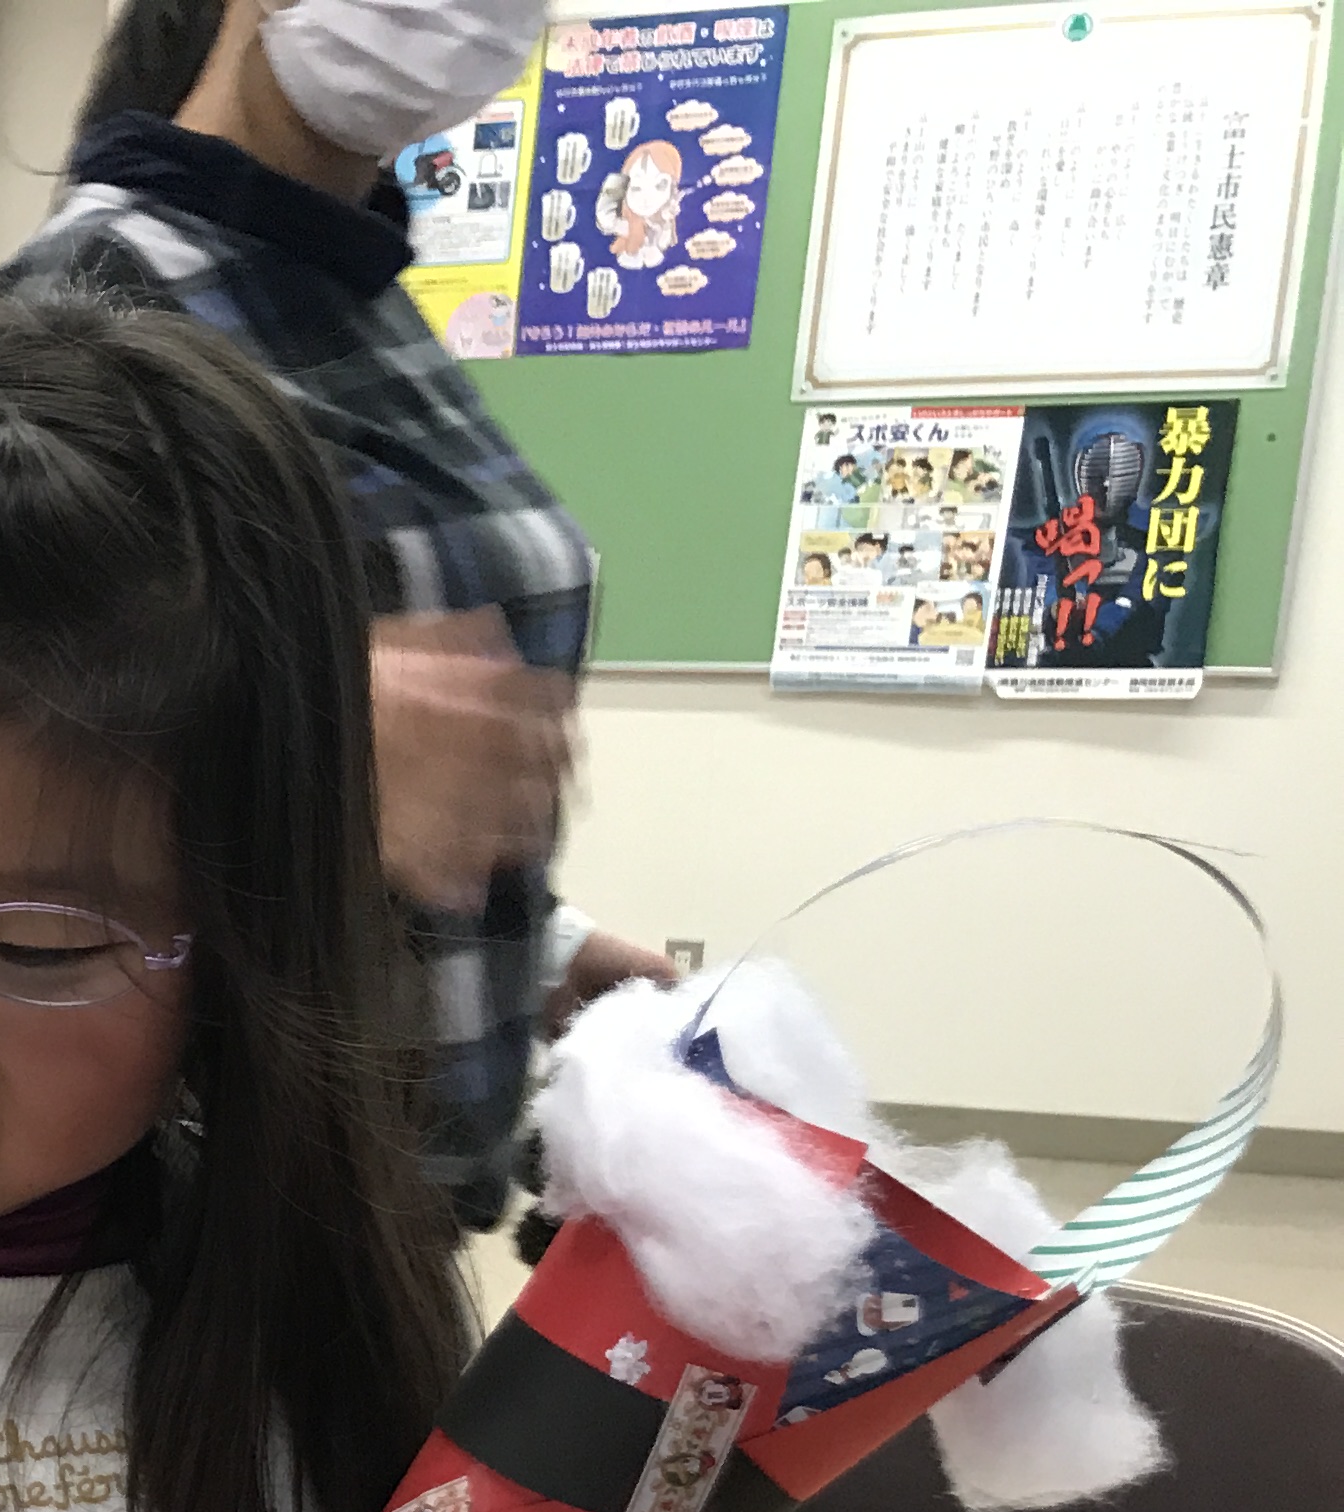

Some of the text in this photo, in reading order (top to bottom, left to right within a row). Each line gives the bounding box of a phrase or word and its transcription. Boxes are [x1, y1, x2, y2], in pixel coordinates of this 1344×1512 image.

[1203, 110, 1250, 291] 富士市民憲章
[846, 422, 949, 443] スポ安くん
[1142, 405, 1211, 601] 暴力団に
